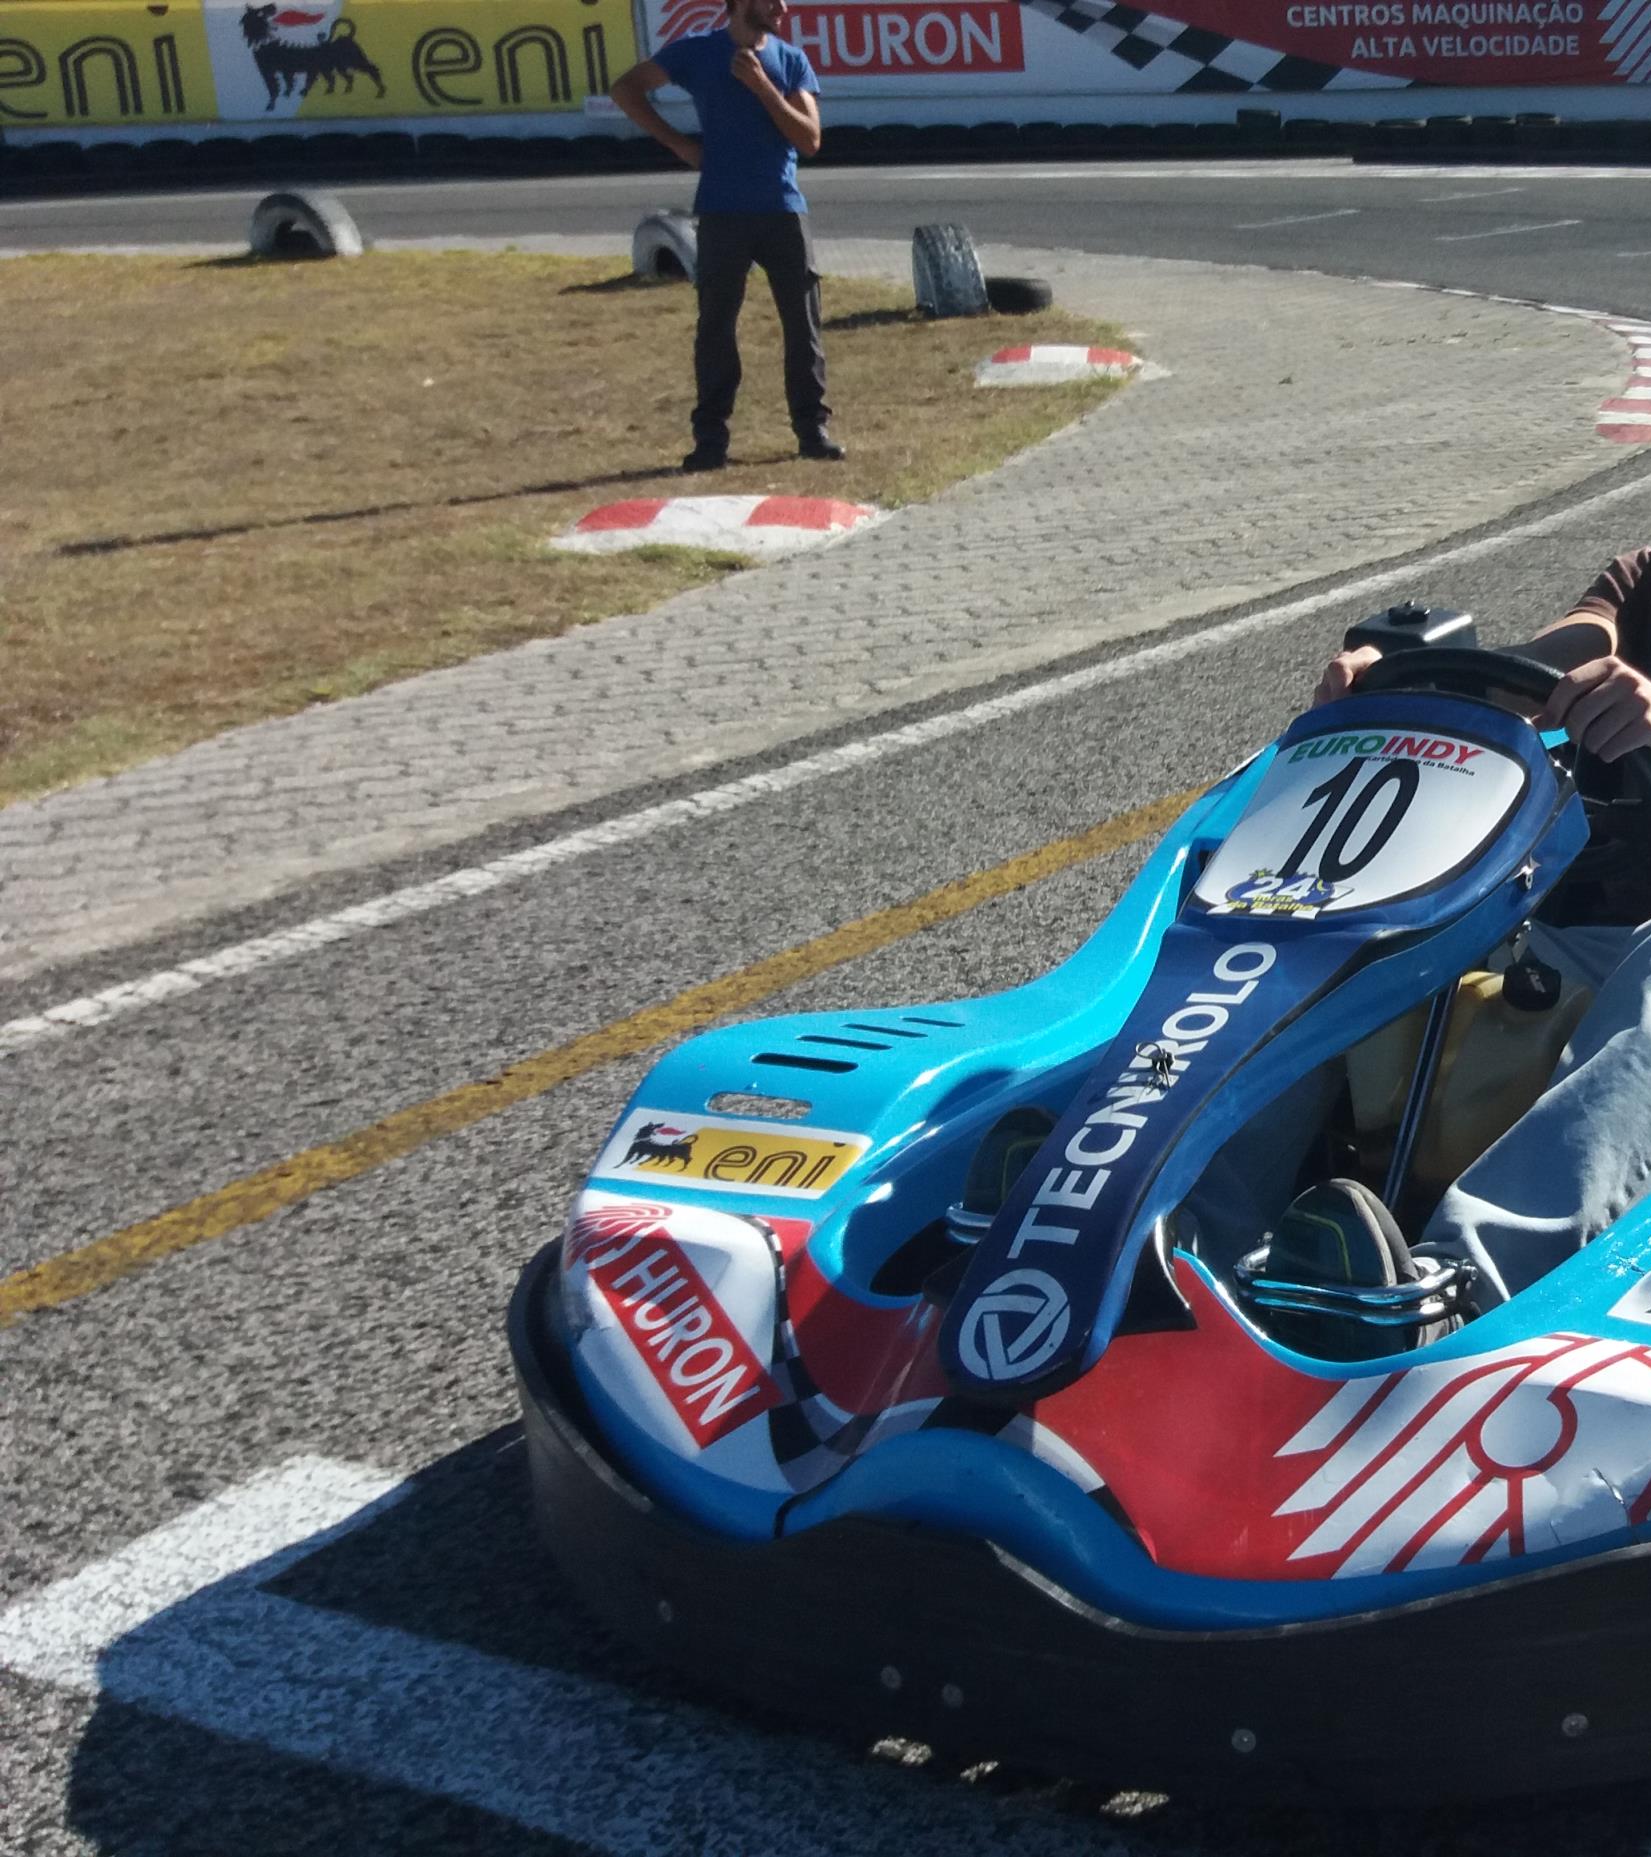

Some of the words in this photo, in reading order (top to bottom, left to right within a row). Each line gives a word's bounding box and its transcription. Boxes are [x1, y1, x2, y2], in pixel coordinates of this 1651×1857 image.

[1286, 4, 1405, 28] CENTROS
[1412, 0, 1584, 29] MAQUINAÇÃO
[412, 0, 611, 106] eni
[789, 12, 1002, 67] HURON
[1351, 36, 1417, 59] ALTA
[1422, 34, 1580, 57] VELOCIDADE
[1287, 734, 1486, 766] EUROINDY
[1422, 758, 1435, 768] da
[1437, 762, 1476, 777] Batalha
[1277, 756, 1421, 883] 10
[1240, 874, 1317, 900] 24
[1006, 941, 1278, 1260] TECNIROLO
[703, 1141, 847, 1190] eni
[610, 1248, 761, 1428] HURON
